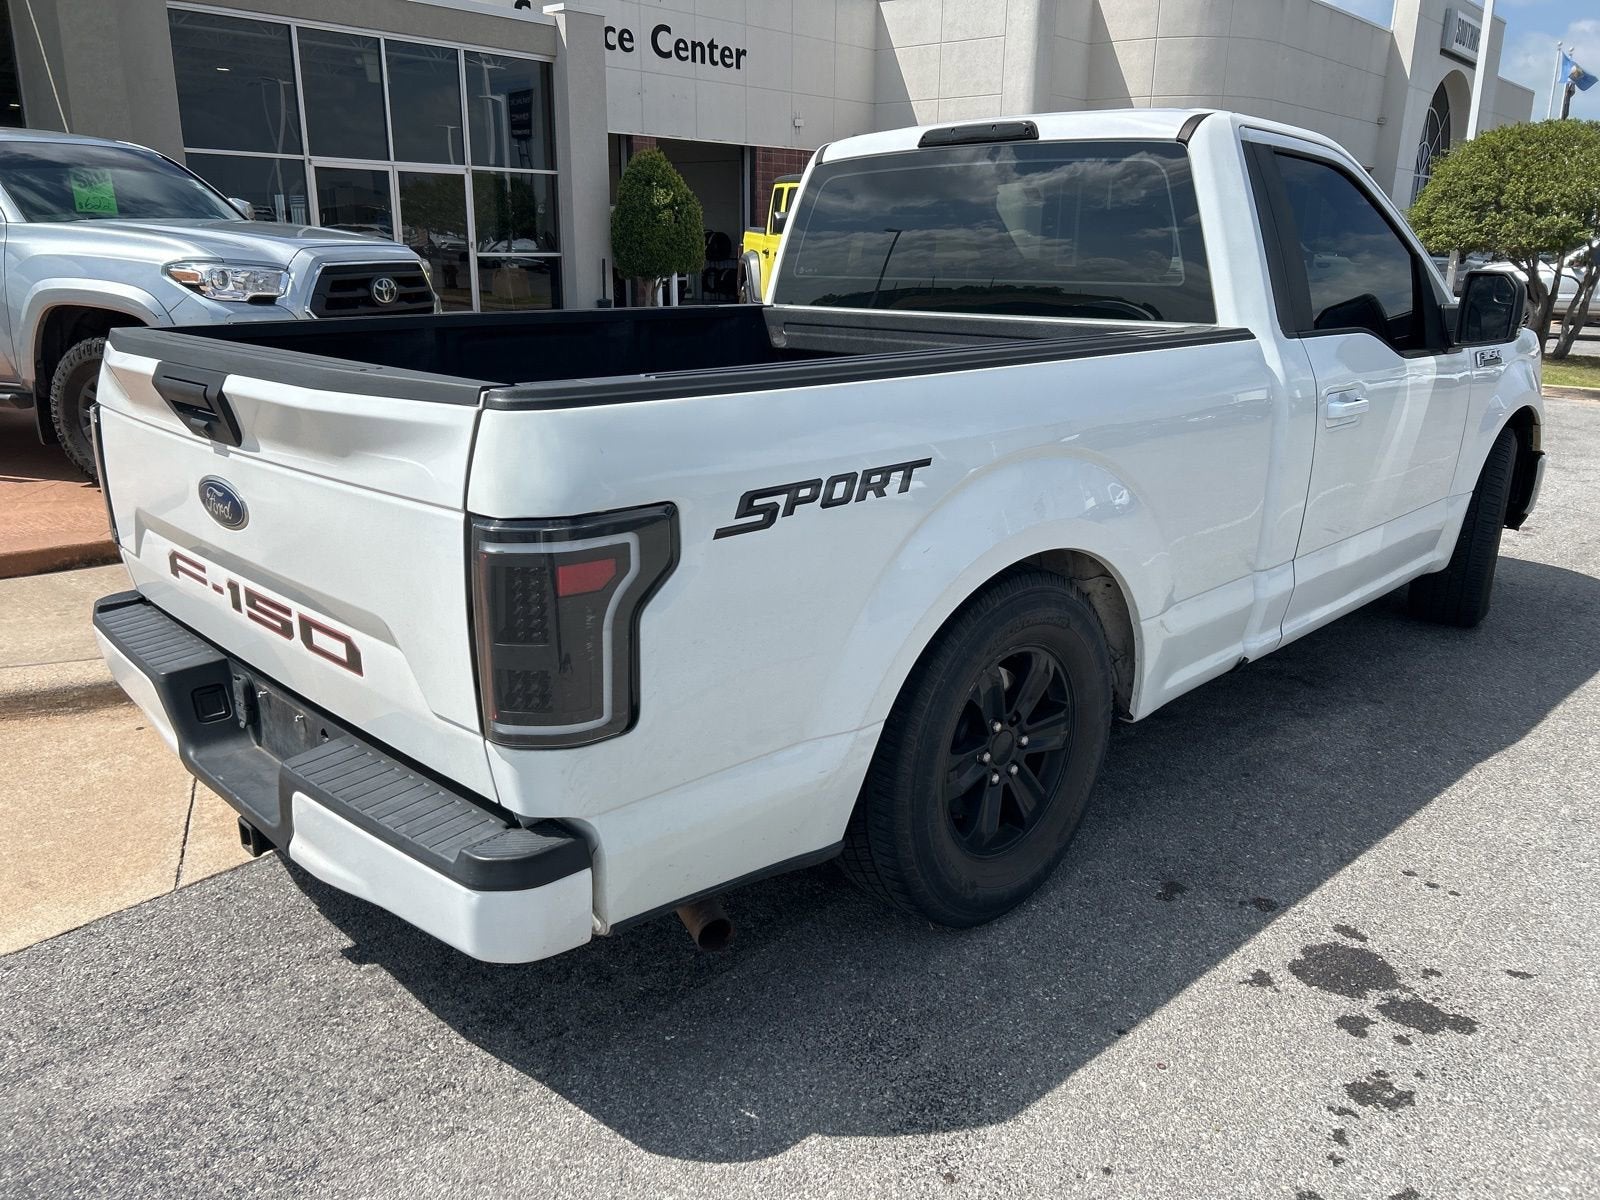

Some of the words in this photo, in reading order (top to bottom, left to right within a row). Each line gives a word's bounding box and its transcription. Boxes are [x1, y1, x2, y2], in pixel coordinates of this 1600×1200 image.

[650, 23, 747, 70] Center
[712, 457, 933, 541] SPORT
[168, 549, 364, 677] F-150
